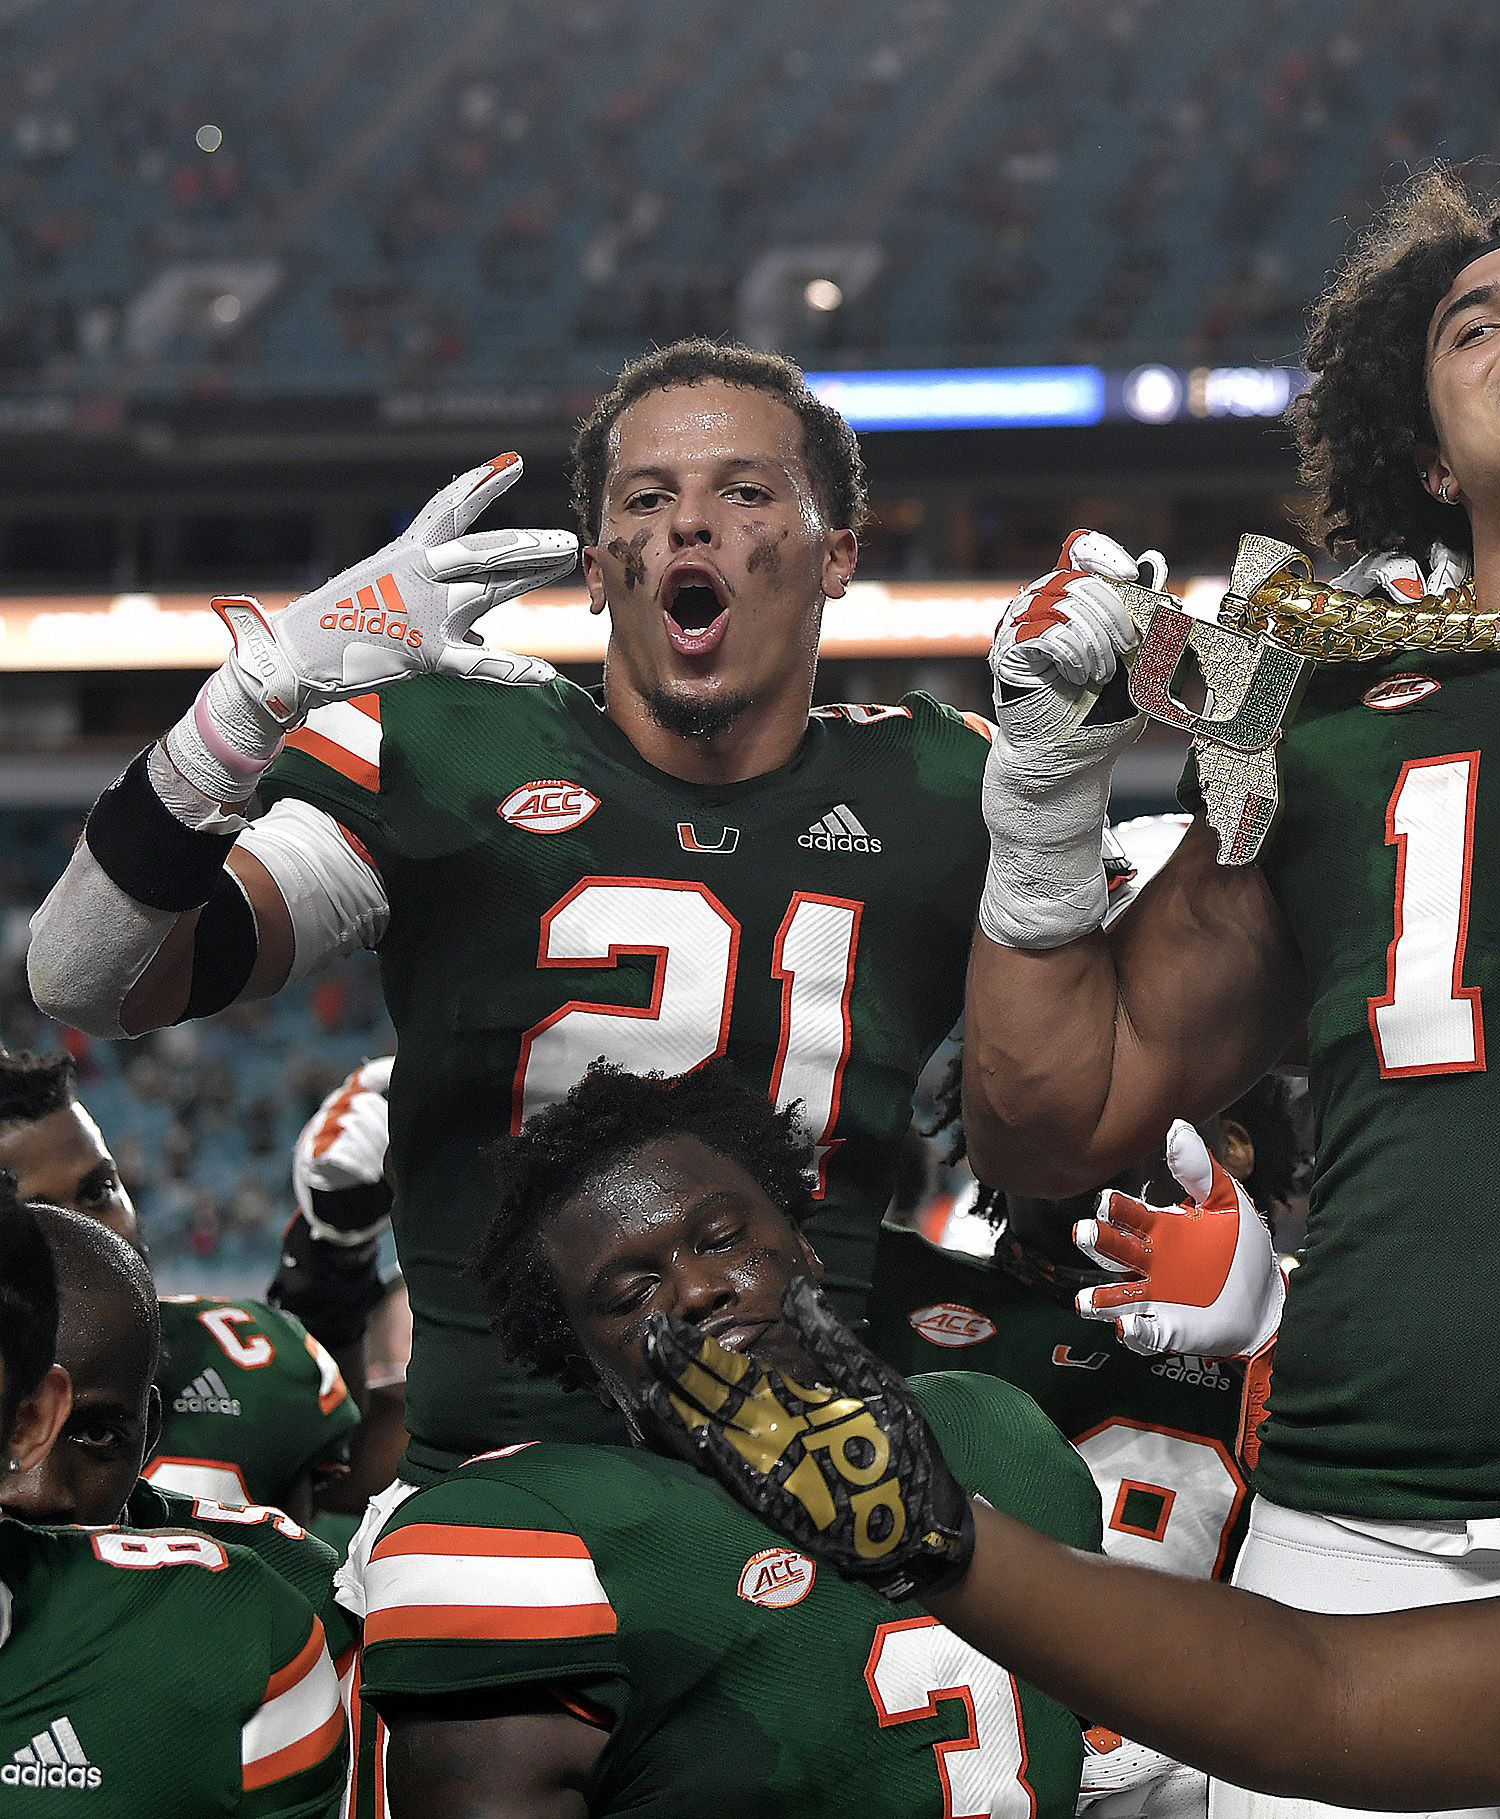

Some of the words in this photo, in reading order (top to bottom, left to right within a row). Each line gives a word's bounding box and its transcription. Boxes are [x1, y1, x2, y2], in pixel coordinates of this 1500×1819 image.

[320, 608, 424, 649] adidas
[514, 788, 583, 816] ACC
[797, 828, 883, 854] adidas
[510, 875, 865, 1200] 21
[920, 1312, 986, 1337] ACC
[1150, 1362, 1232, 1391] adidas
[172, 1396, 243, 1417] adidas
[753, 1554, 806, 1594] ACC
[0, 1760, 103, 1789] adidas
